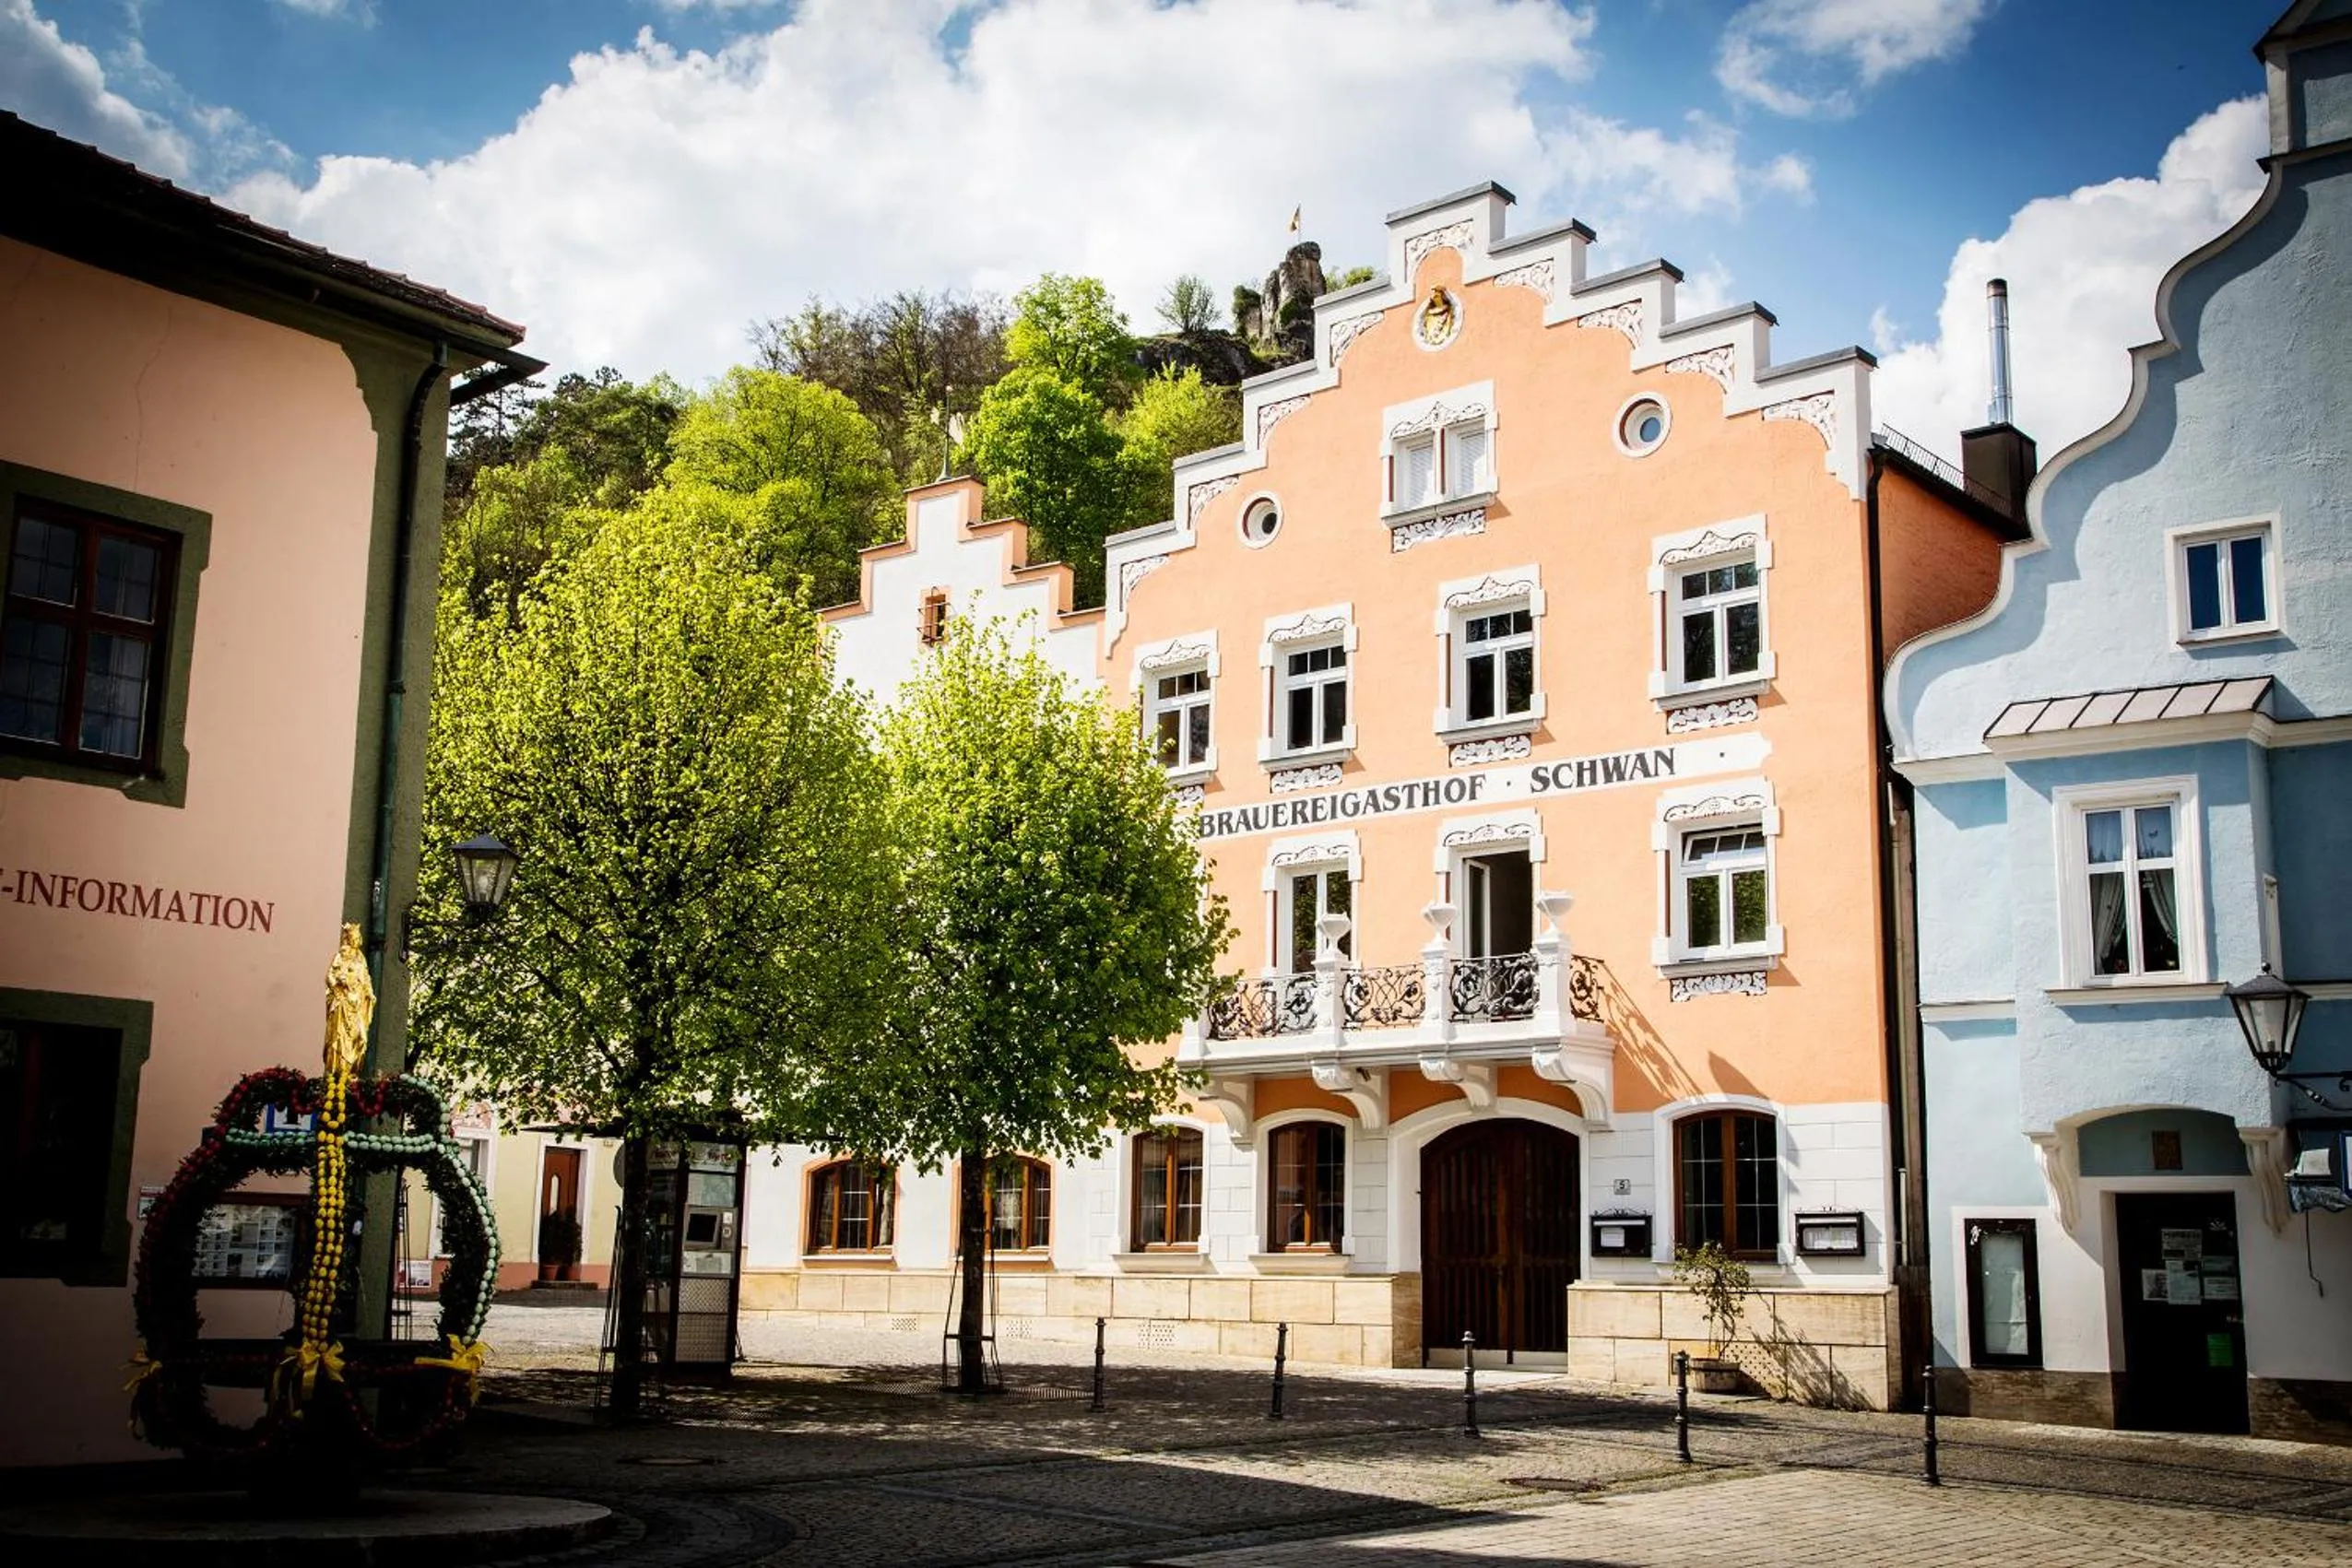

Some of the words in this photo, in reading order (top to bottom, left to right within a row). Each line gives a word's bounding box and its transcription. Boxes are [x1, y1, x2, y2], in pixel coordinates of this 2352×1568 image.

[1200, 773, 1486, 838] BRAUEREIGASTHOF
[1531, 748, 1675, 794] SCHWAN
[0, 867, 275, 933] -INFORMATION
